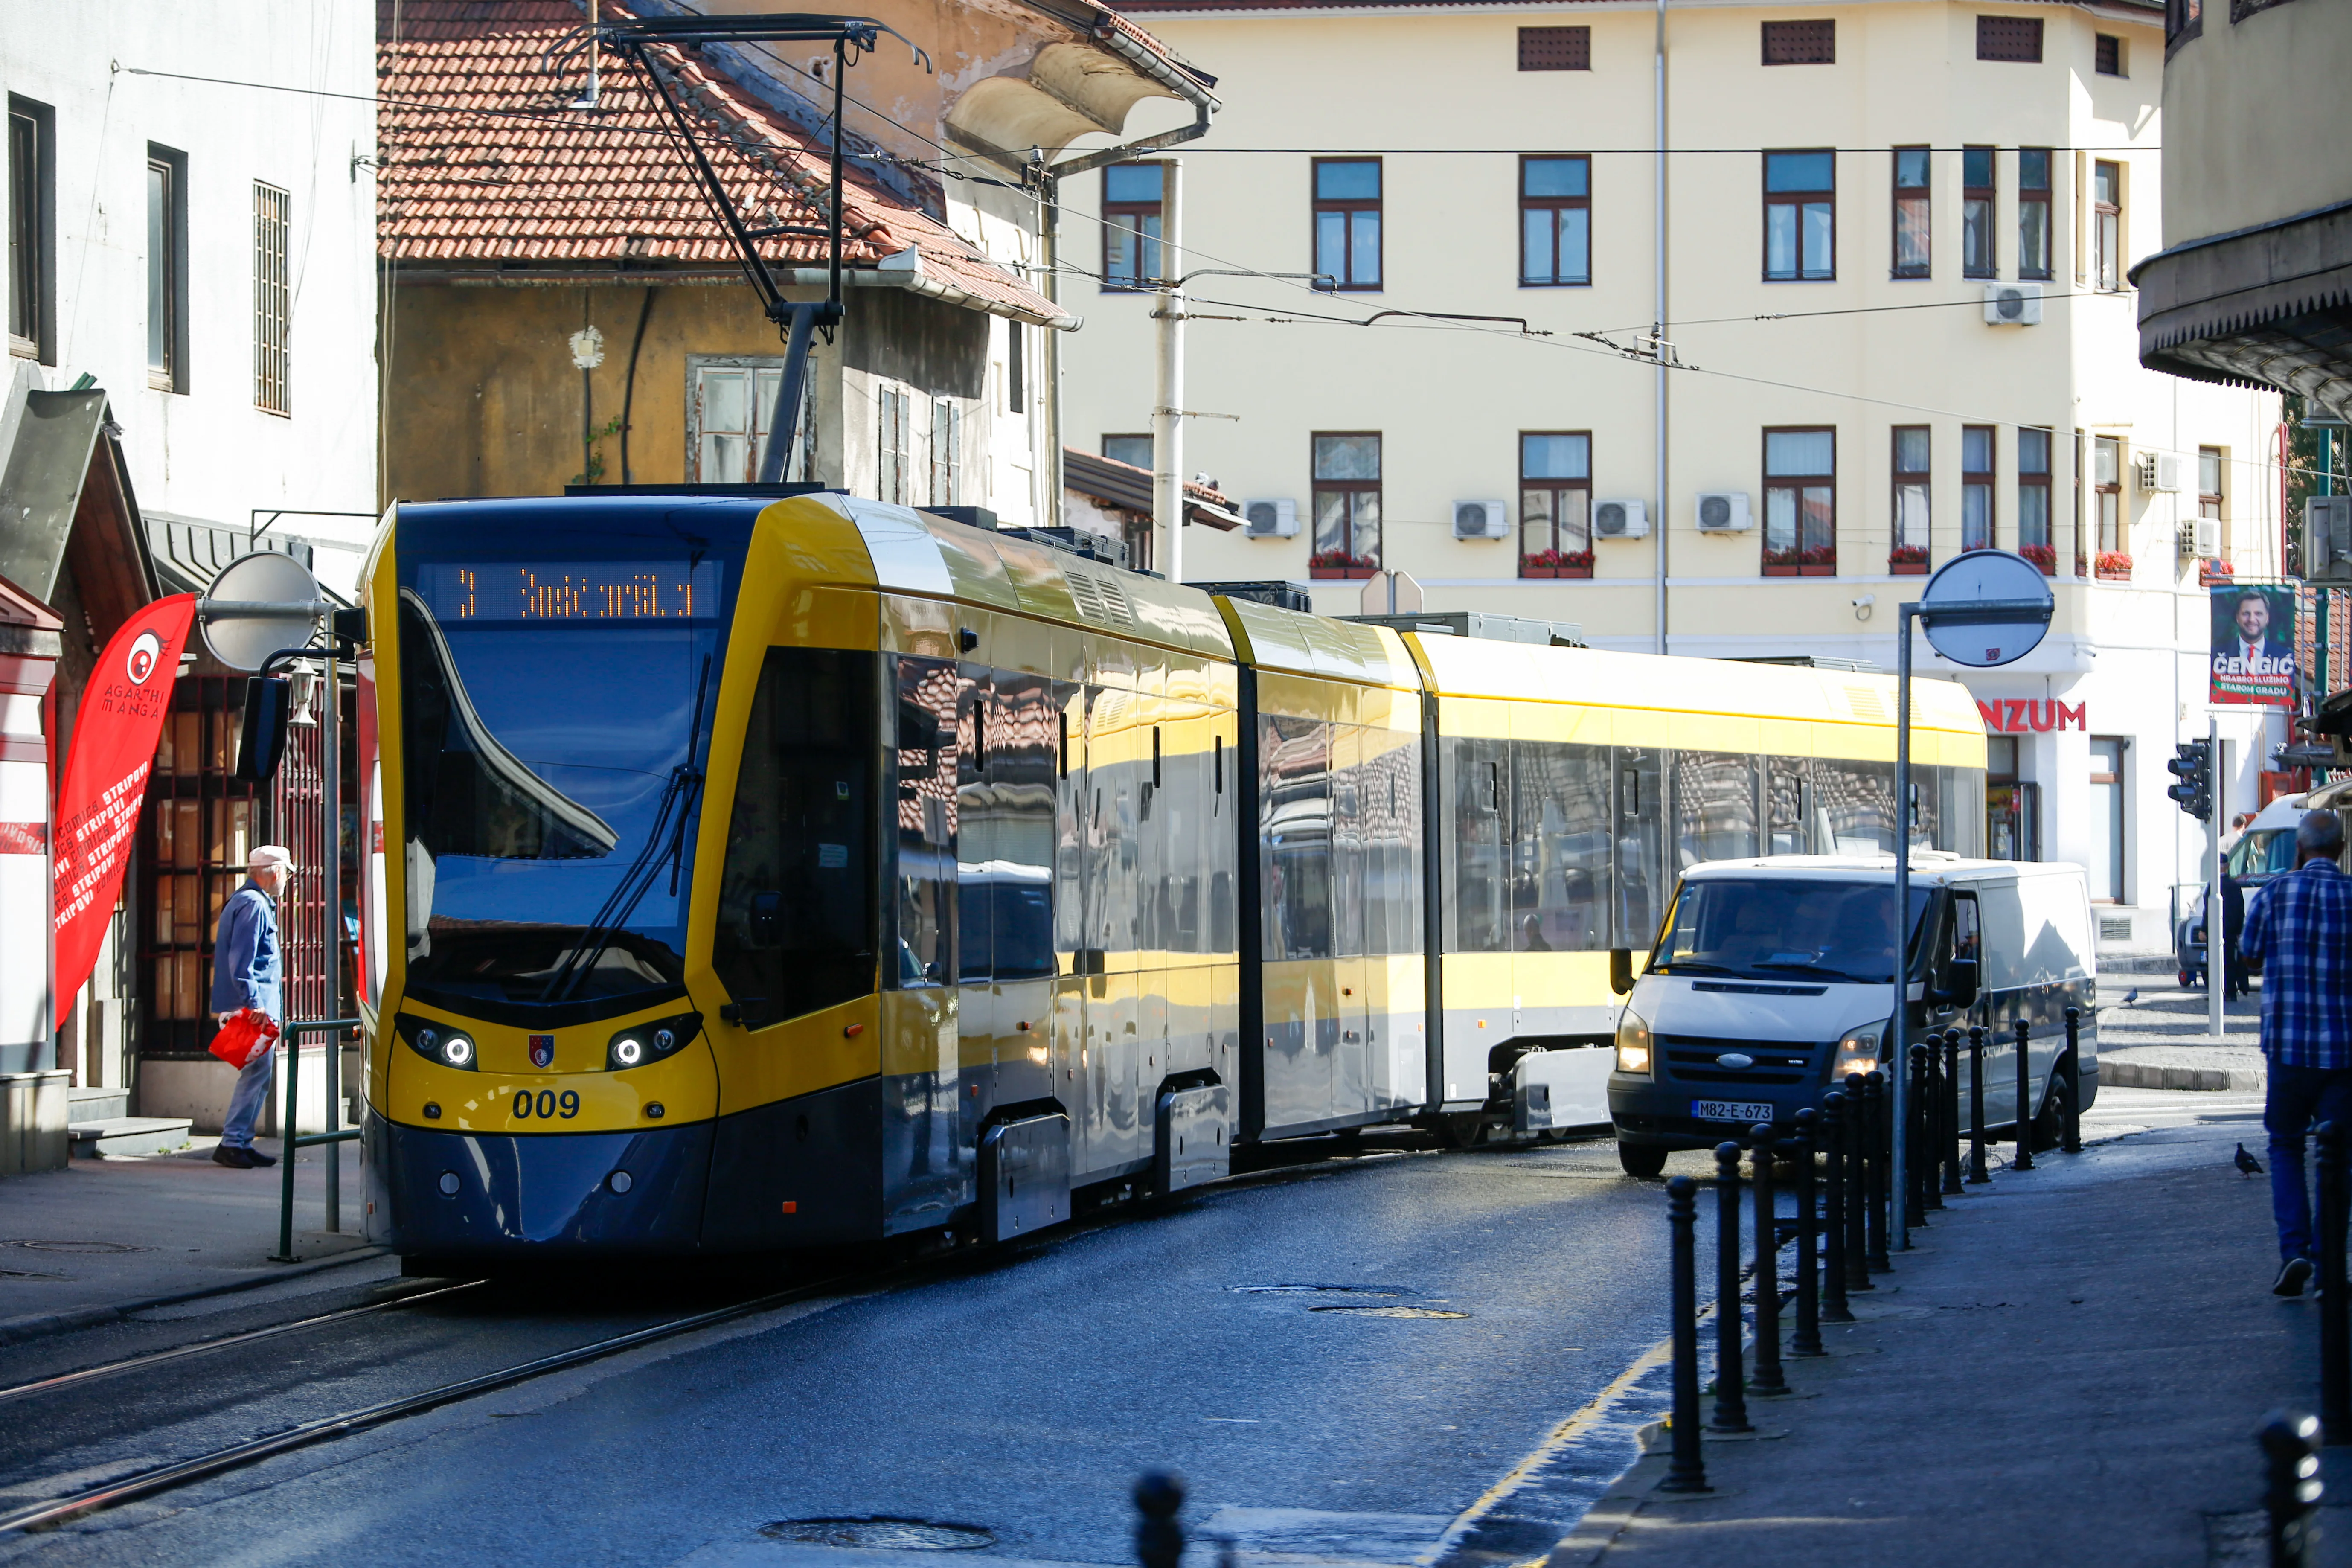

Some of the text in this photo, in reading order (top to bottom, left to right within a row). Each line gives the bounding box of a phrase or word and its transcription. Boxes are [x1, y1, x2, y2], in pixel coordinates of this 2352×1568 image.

[2213, 652, 2294, 675] ČENGIĆ
[2220, 674, 2290, 684] HRABRO SLUŽIMO
[2221, 683, 2287, 695] STAROM GRADU
[102, 698, 158, 720] MANGA
[58, 761, 148, 839] COMICS STRIPOVI
[76, 797, 125, 842] STRIPOVI
[70, 825, 110, 863] COMICS
[88, 821, 130, 867] STRIPOVI
[72, 852, 115, 898] STRIPOVI
[55, 856, 127, 934] TRIPOVI COMICS
[513, 1089, 579, 1119] 009
[1700, 1102, 1770, 1119] M82-E-673
